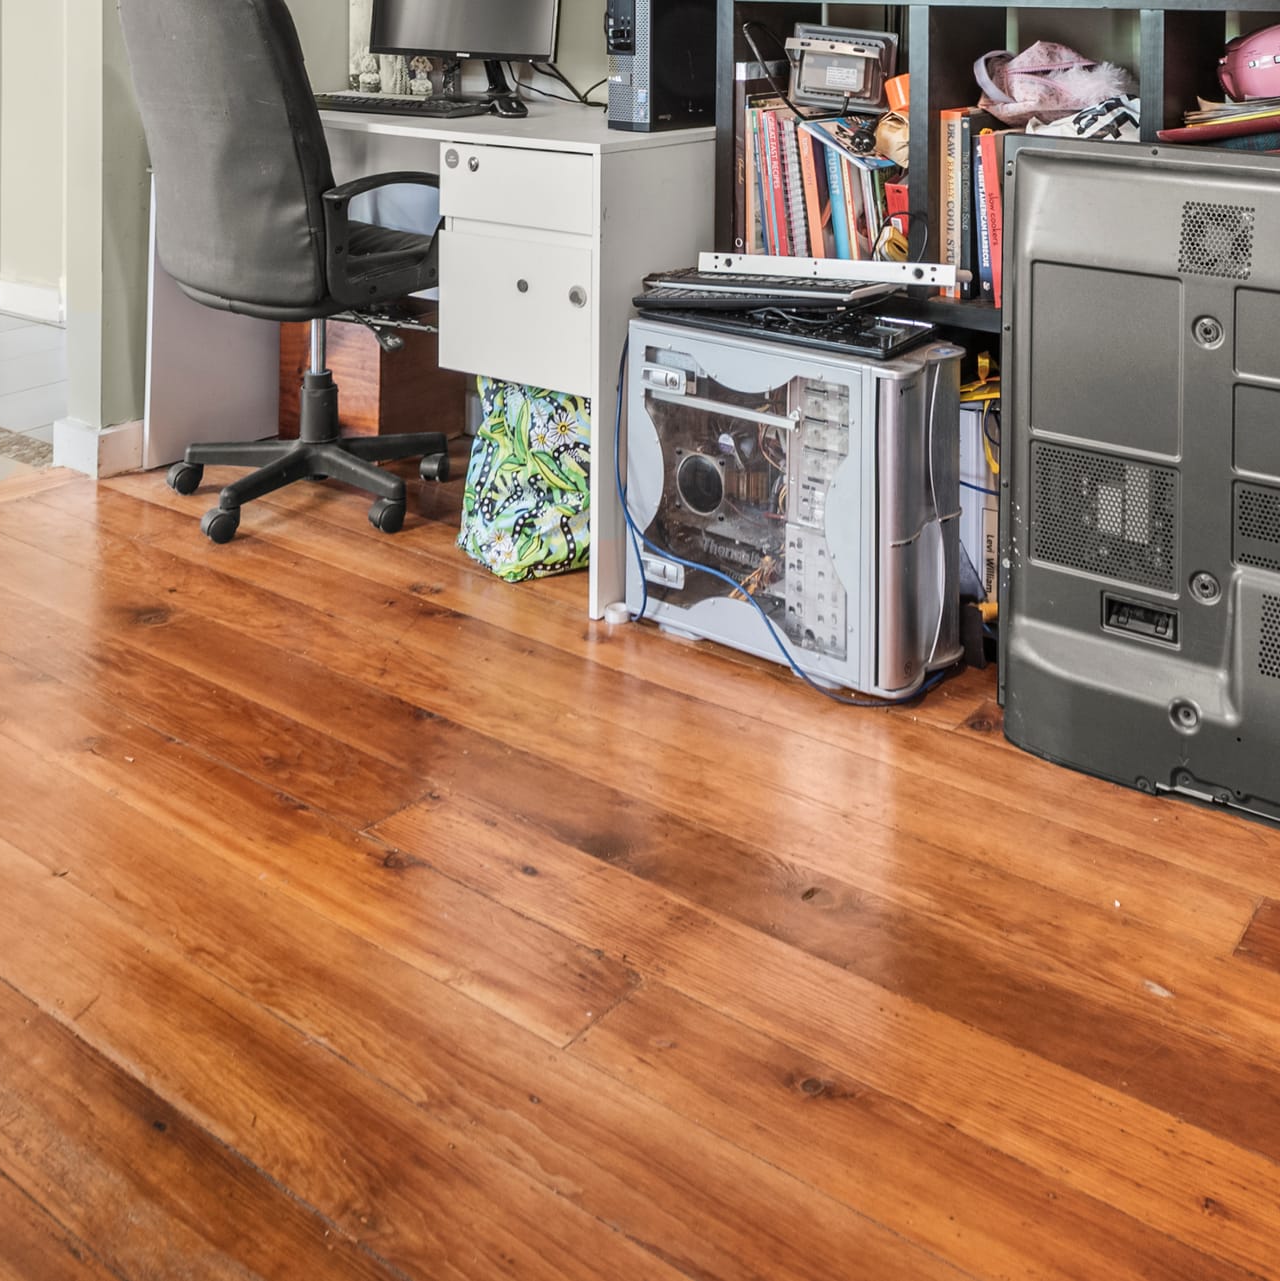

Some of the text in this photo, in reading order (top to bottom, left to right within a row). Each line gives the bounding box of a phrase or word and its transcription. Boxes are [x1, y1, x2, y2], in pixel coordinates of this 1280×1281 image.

[768, 116, 781, 189] GREAT FAST RECIPES
[961, 151, 970, 163] The
[946, 123, 956, 265] DRAW REALLY COOL STU
[961, 180, 970, 212] Collection
[978, 192, 988, 231] AMERICAN
[961, 213, 970, 232] Soup
[987, 191, 1001, 247] slow cookers
[985, 533, 995, 593] Levi William
